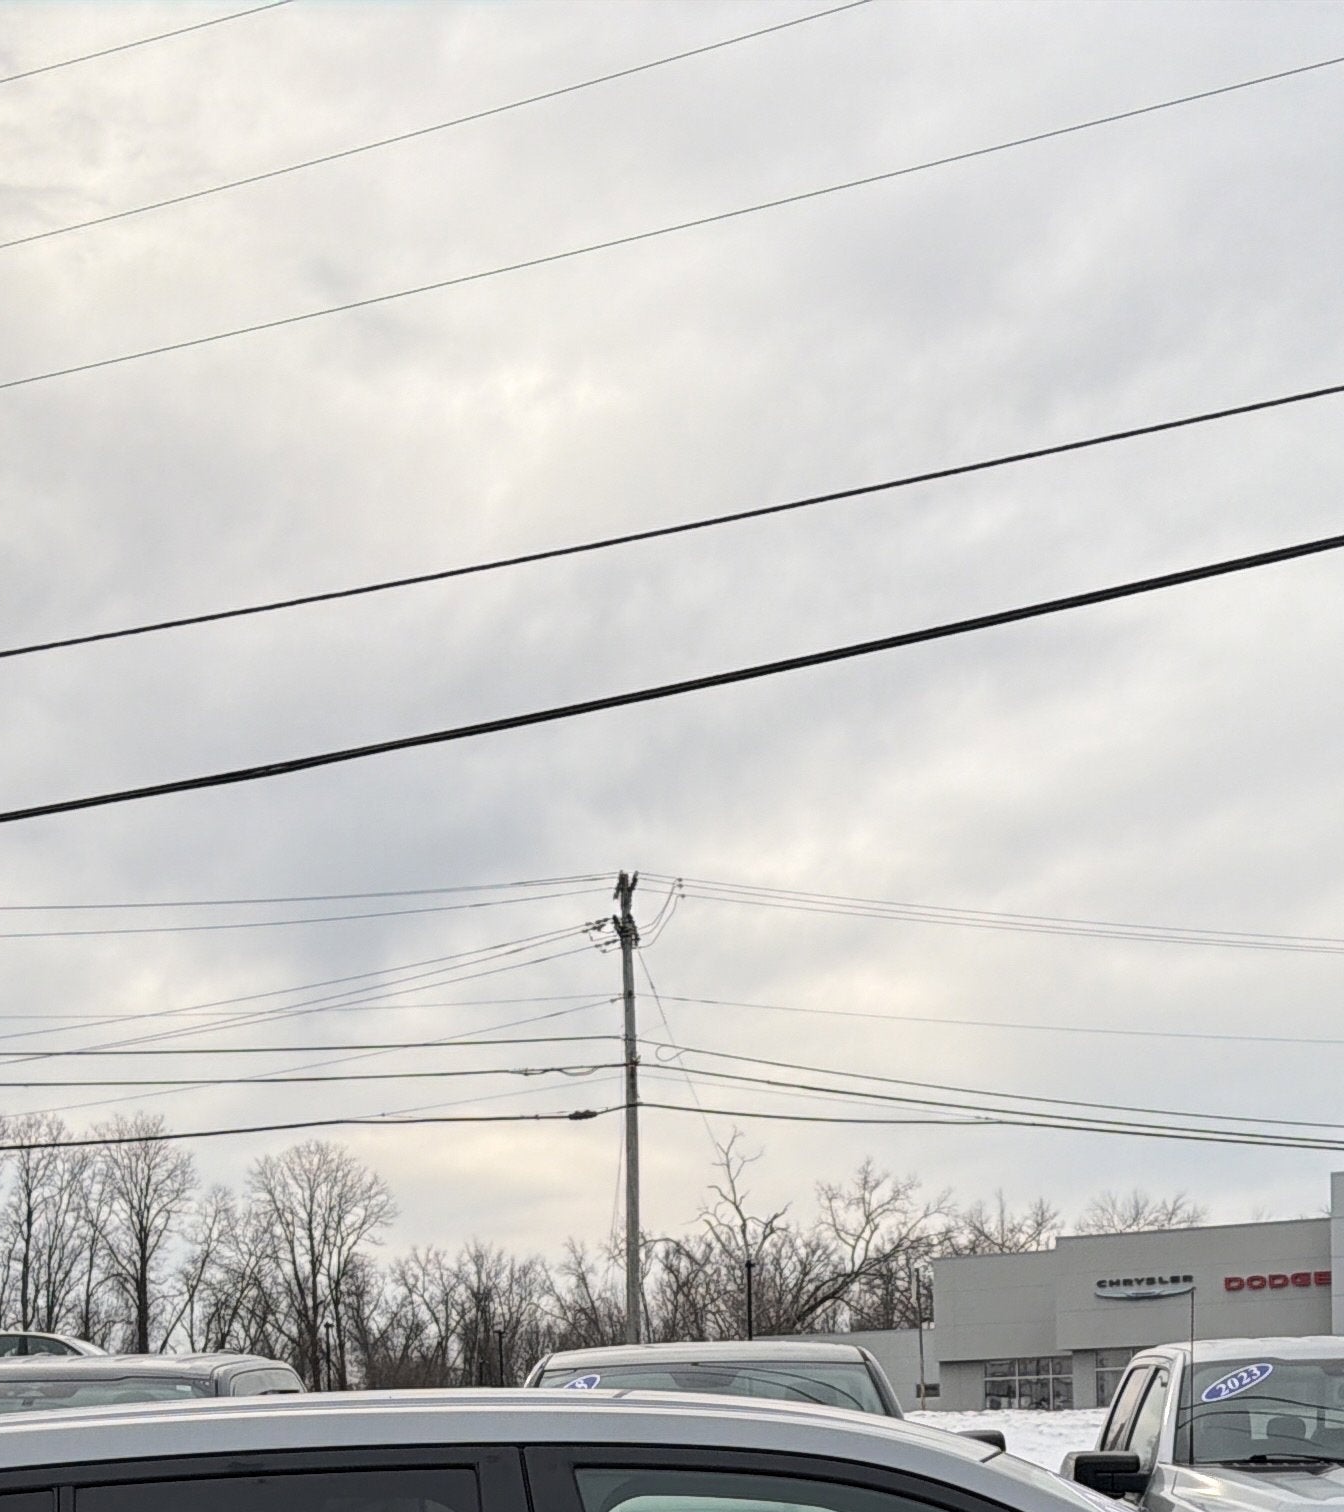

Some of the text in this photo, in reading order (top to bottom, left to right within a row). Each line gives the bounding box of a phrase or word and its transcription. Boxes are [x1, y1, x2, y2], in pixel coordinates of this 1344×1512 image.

[1096, 1275, 1194, 1288] CHRYSLER
[1224, 1270, 1332, 1291] DODGE
[1216, 1366, 1261, 1396] 2023
